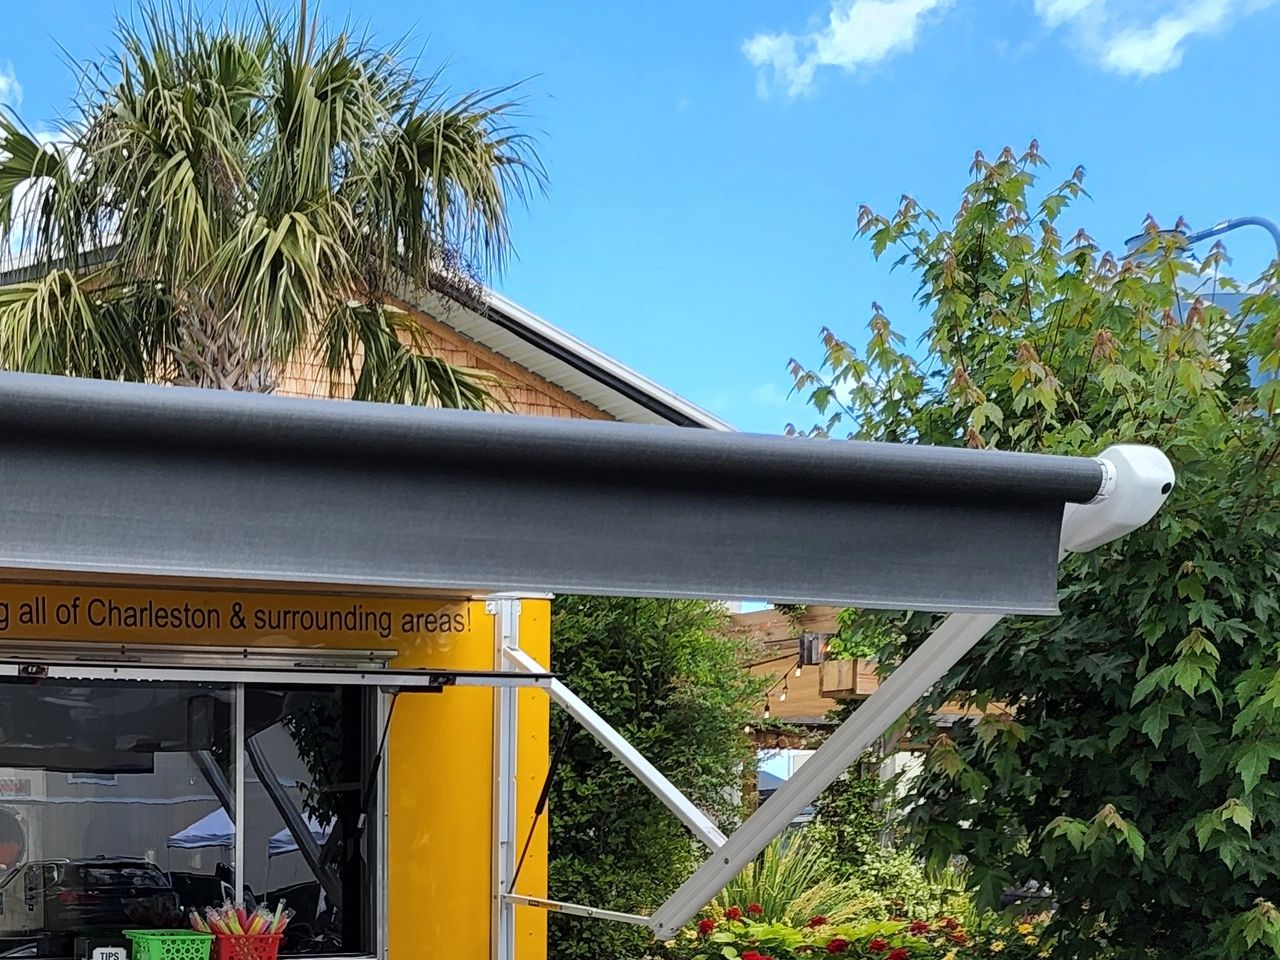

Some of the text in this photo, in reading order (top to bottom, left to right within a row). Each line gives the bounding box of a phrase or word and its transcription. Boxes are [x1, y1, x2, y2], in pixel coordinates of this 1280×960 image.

[19, 596, 47, 625] all
[55, 596, 80, 626] of
[87, 598, 220, 630] Charleston
[229, 602, 247, 630] &
[254, 604, 392, 638] surrounding
[401, 605, 472, 635] areas!
[100, 952, 120, 960] TIPS
